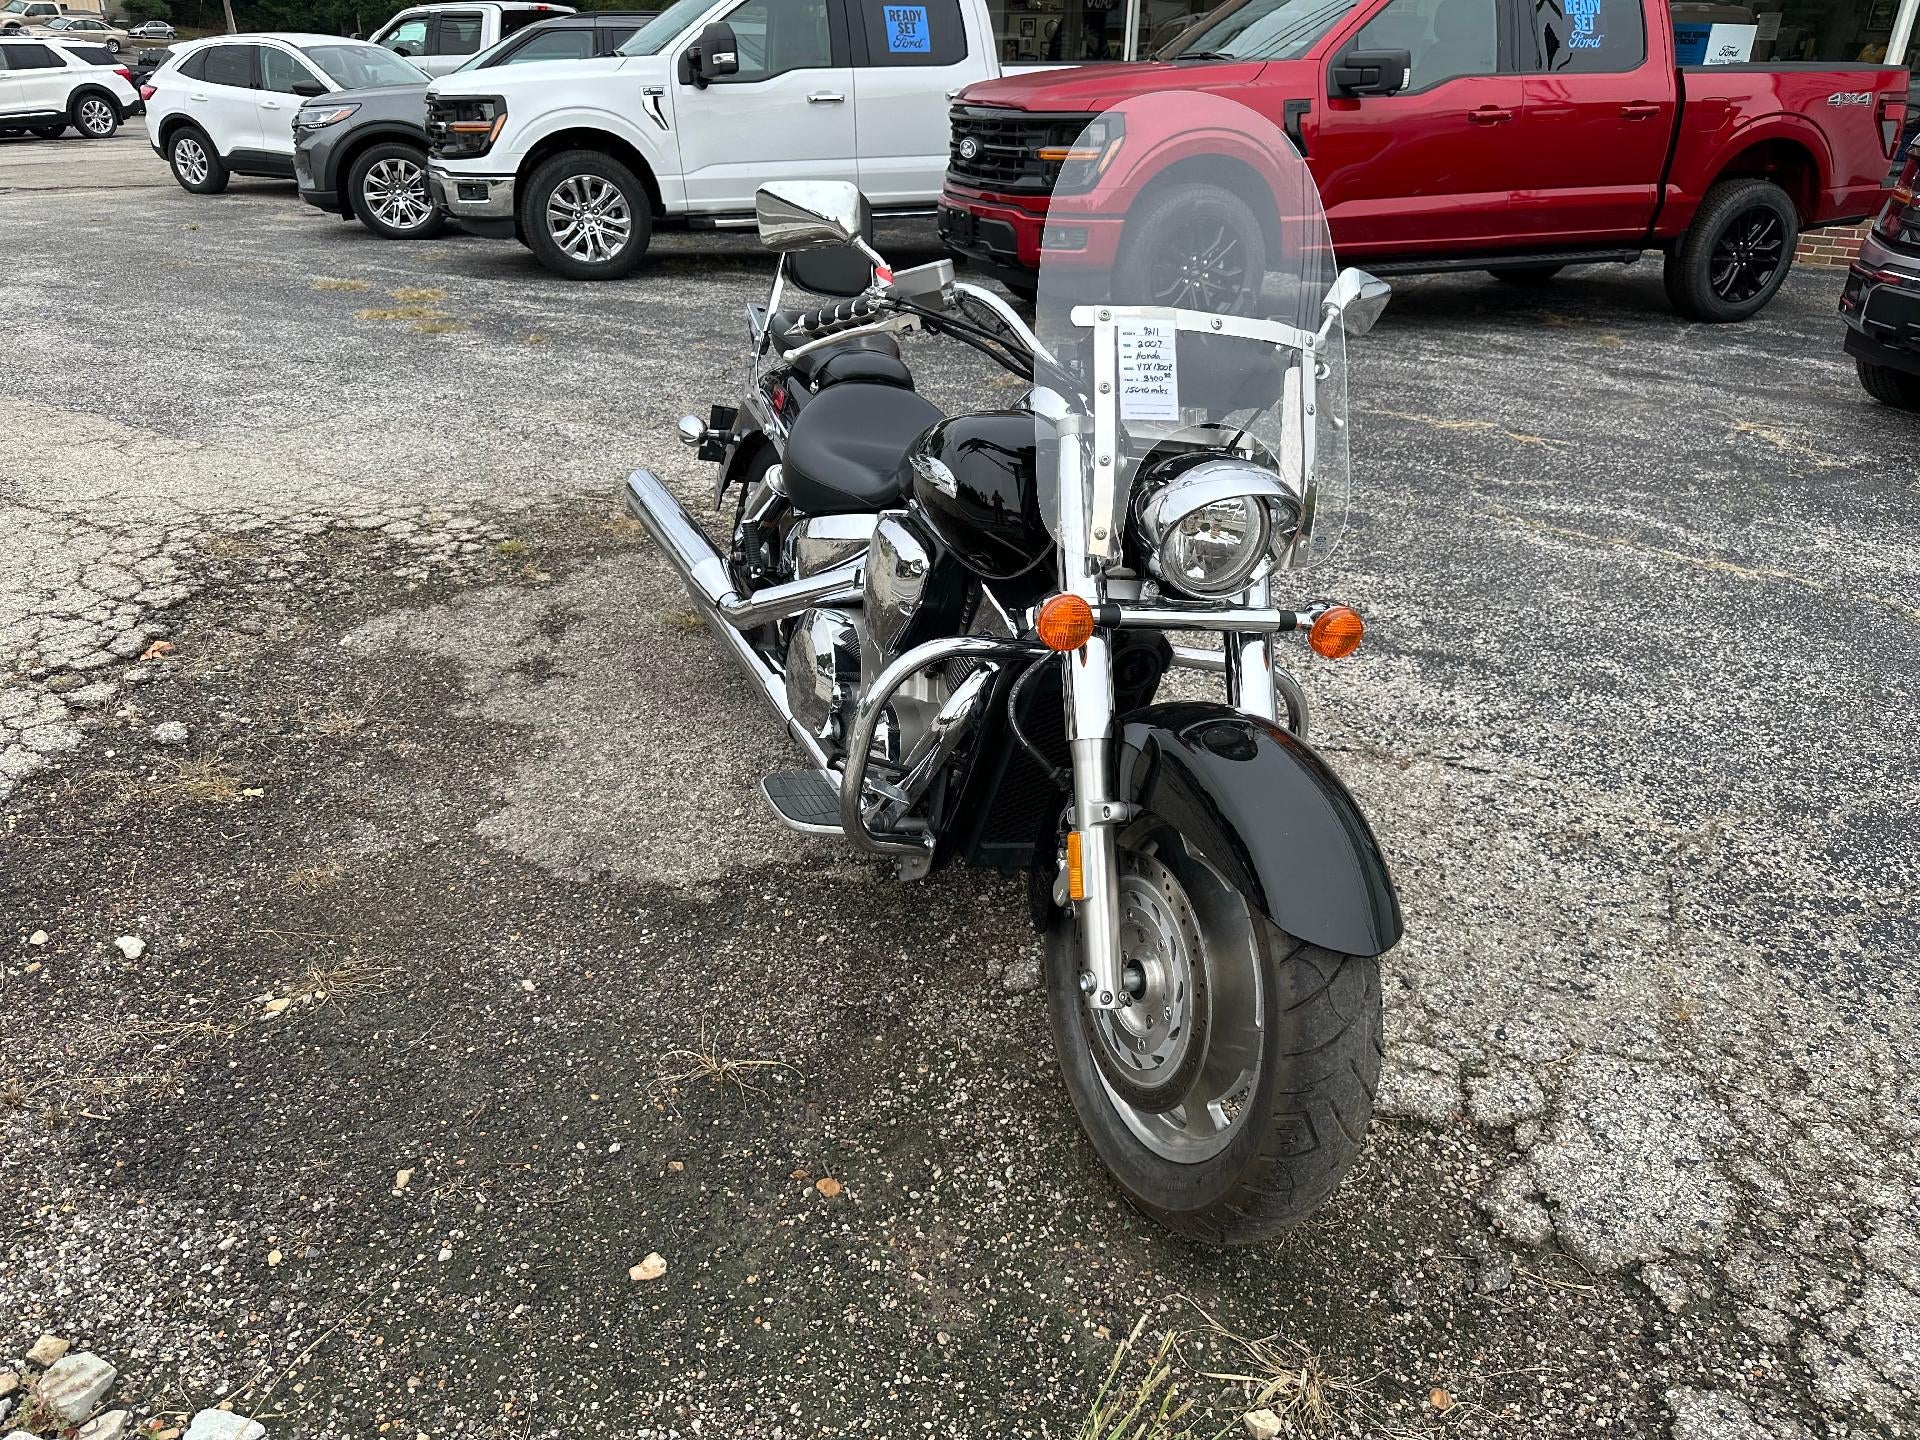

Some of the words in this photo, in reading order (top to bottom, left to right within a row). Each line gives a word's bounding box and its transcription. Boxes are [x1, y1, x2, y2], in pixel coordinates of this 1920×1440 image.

[1564, 0, 1601, 15] READY
[888, 9, 922, 22] READY
[1573, 14, 1595, 30] SET
[897, 22, 916, 34] SET
[892, 34, 924, 49] Ford
[1568, 29, 1605, 49] Ford
[1718, 45, 1741, 57] Ford
[1137, 340, 1163, 349] 2007
[1136, 349, 1161, 360] Honda
